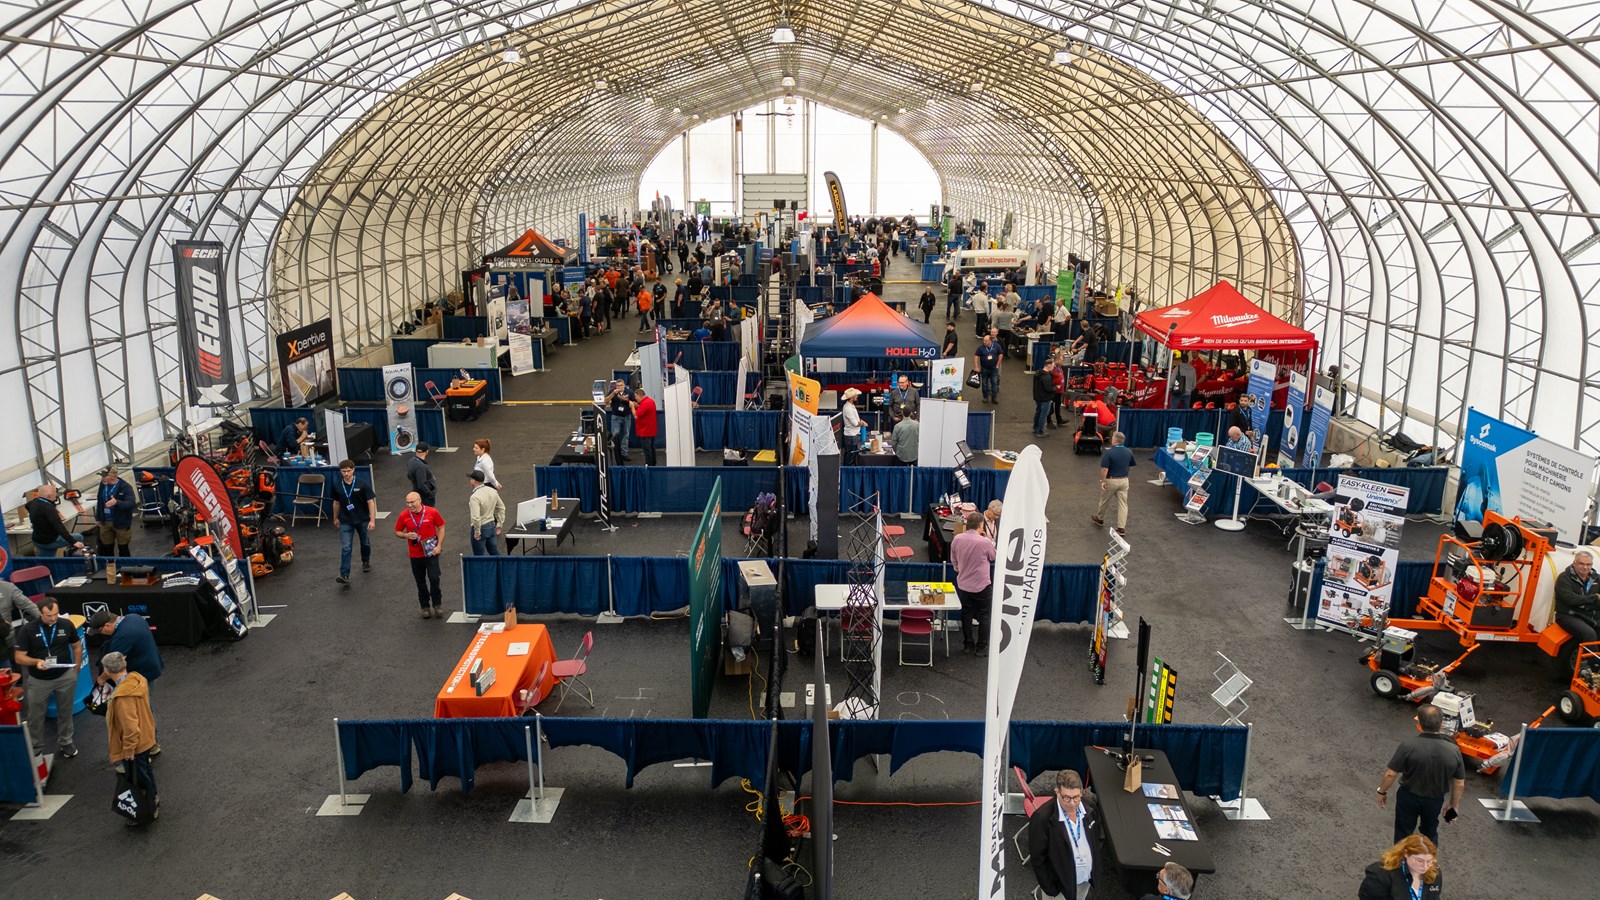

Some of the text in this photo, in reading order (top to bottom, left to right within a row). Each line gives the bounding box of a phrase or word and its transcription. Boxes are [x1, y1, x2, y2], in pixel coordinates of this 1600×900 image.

[831, 184, 845, 231] LAROCHELLE
[191, 265, 221, 356] ECHO
[1209, 312, 1260, 325] Milwaukee
[287, 331, 326, 358] Xpertive
[1525, 459, 1567, 482] POUR MACHINERIE
[1526, 450, 1584, 480] SYSTÈMES DE CONTRÔLE
[1340, 478, 1387, 493] EASY-KLEEN
[1523, 467, 1572, 493] LOURDE ET CAMIONS
[1022, 529, 1043, 601] HARNOIS
